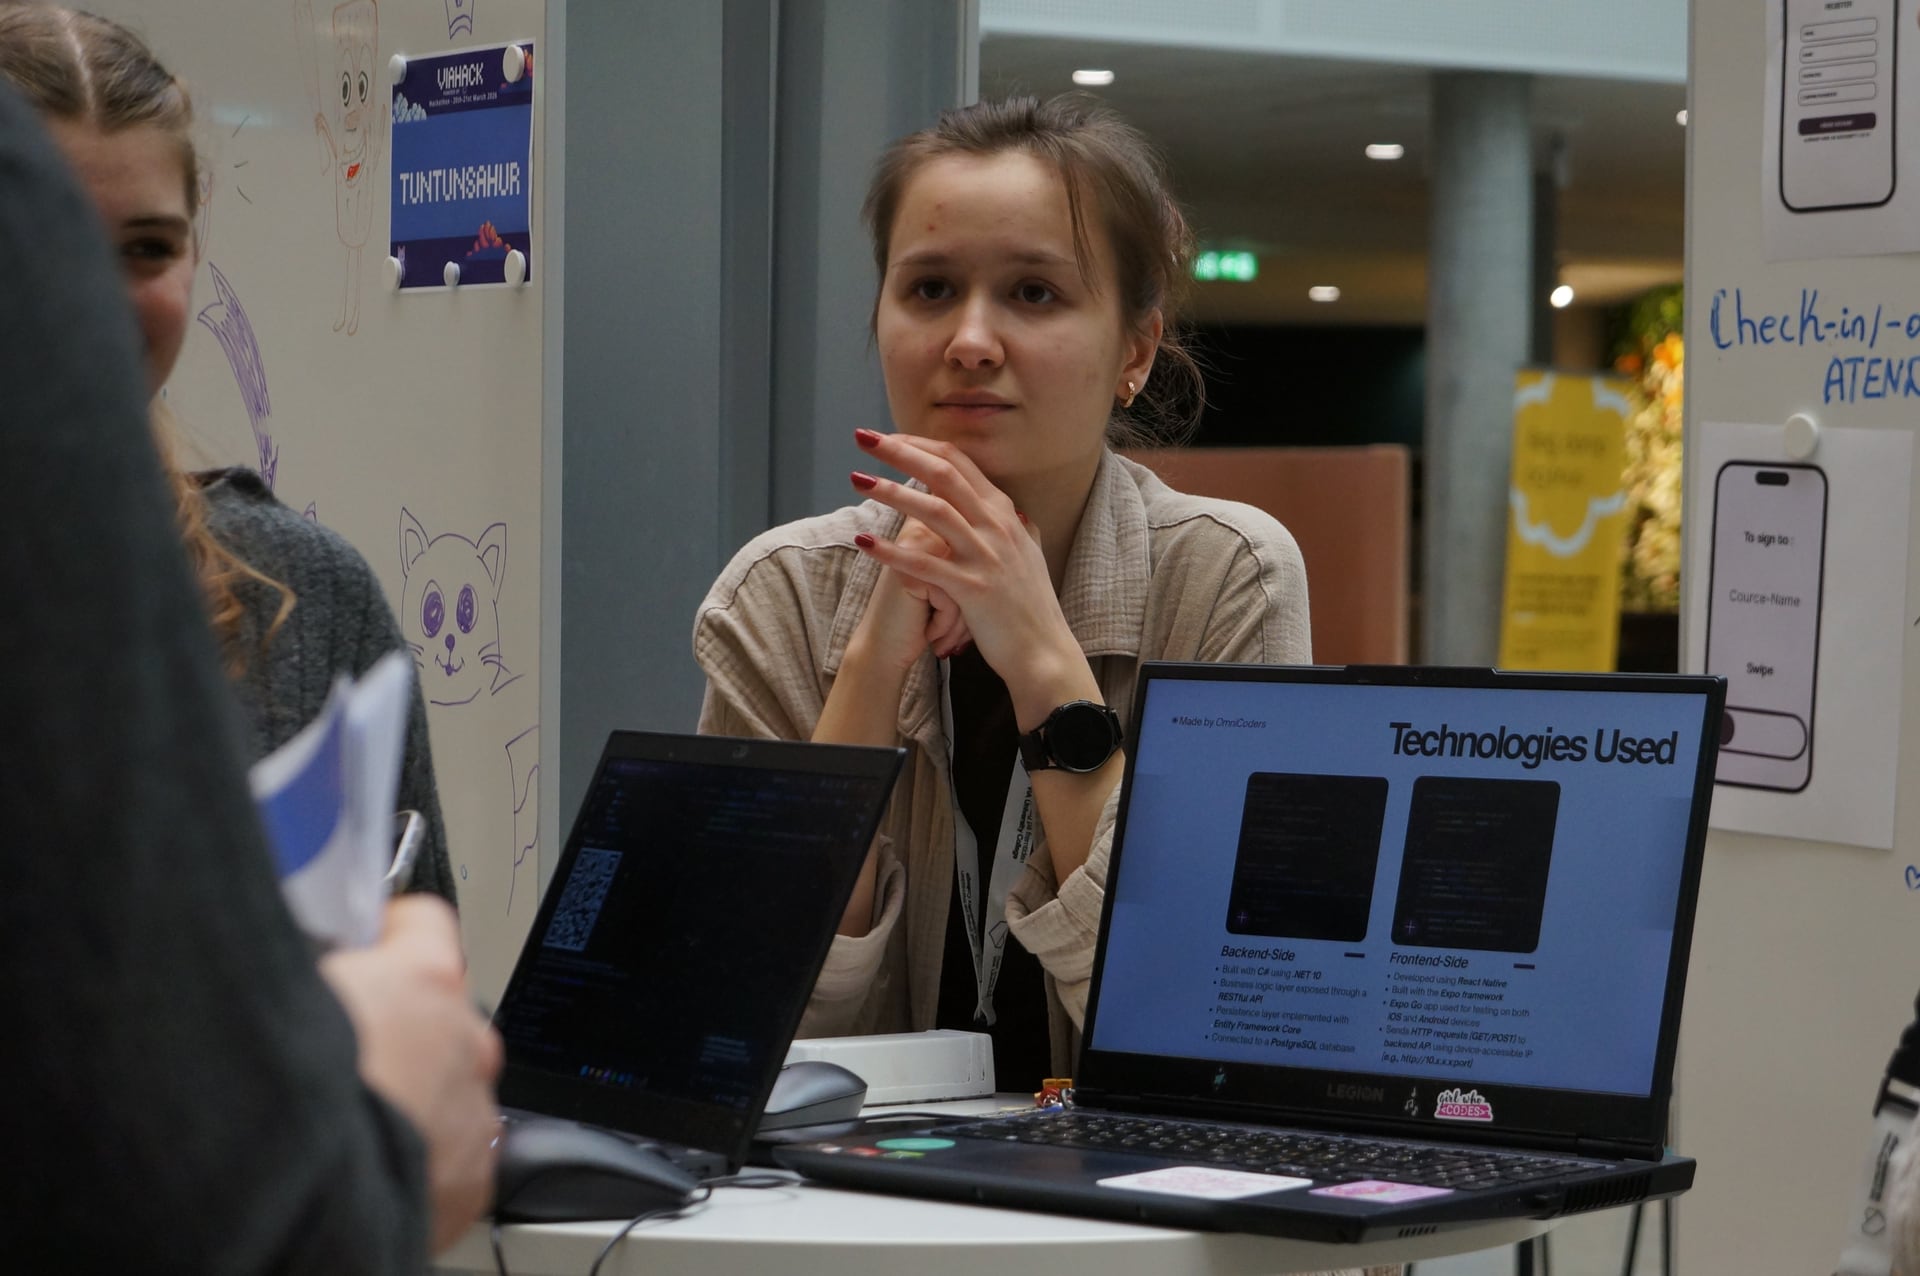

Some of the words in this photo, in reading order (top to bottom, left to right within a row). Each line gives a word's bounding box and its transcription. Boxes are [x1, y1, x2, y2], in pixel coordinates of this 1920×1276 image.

[437, 62, 484, 90] VIAHACK
[400, 161, 521, 205] TUNTUNSAHUR
[1744, 531, 1755, 543] To
[1757, 533, 1775, 547] sign
[1729, 588, 1800, 607] Cource-Name
[1746, 662, 1774, 678] Swipe
[1179, 716, 1202, 726] Made
[1203, 717, 1215, 728] by
[1215, 717, 1267, 728] OmniCoders
[1389, 722, 1588, 769] Technologies
[1594, 728, 1678, 764] Used
[1016, 799, 1033, 833] University
[1012, 833, 1024, 860] College
[1221, 945, 1296, 962] Backend-Side
[1390, 952, 1469, 969] Frontend-Side
[1222, 964, 1239, 975] Built
[1240, 966, 1256, 976] with
[1257, 966, 1270, 976] C#
[1271, 968, 1291, 979] using
[1292, 969, 1311, 979] .NET
[1312, 970, 1322, 980] 10
[1393, 972, 1435, 984] Developed
[1436, 975, 1457, 986] using
[1457, 977, 1481, 987] React
[1482, 979, 1508, 988] Native
[1218, 991, 1248, 1002] RESTful
[1249, 994, 1264, 1004] API
[1255, 980, 1274, 992] logic
[1275, 982, 1294, 993] layer
[1295, 984, 1330, 996] exposed
[1331, 986, 1361, 999] through
[1392, 985, 1408, 995] Built
[1410, 986, 1426, 996] with
[1426, 987, 1439, 997] the
[1440, 989, 1461, 999] Expo
[1462, 990, 1504, 1001] framework
[1216, 1005, 1260, 1018] Persistence
[1261, 1009, 1281, 1021] layer
[1281, 1011, 1332, 1025] implemented
[1333, 1014, 1349, 1025] with
[1389, 998, 1409, 1010] Expo
[1410, 1000, 1422, 1009] Go
[1423, 1002, 1438, 1012] app
[1439, 1002, 1459, 1012] used
[1459, 1003, 1471, 1013] for
[1500, 1006, 1511, 1016] on
[1511, 1006, 1530, 1017] both
[1213, 1019, 1235, 1031] Entity
[1236, 1021, 1281, 1033] Framework
[1282, 1024, 1302, 1035] Core
[1387, 1012, 1401, 1021] iOS
[1402, 1013, 1418, 1023] and
[1418, 1015, 1449, 1024] Android
[1450, 1017, 1480, 1027] devices
[1386, 1025, 1410, 1035] Sends
[1410, 1026, 1432, 1036] HTTP
[1433, 1029, 1468, 1040] requests
[1211, 1032, 1254, 1045] Connected
[1270, 1038, 1318, 1050] PostgreSQL
[1319, 1041, 1356, 1053] database
[1383, 1039, 1417, 1049] backend
[1418, 1041, 1432, 1050] API
[1432, 1044, 1453, 1054] using
[1327, 1083, 1384, 1102] LEGION
